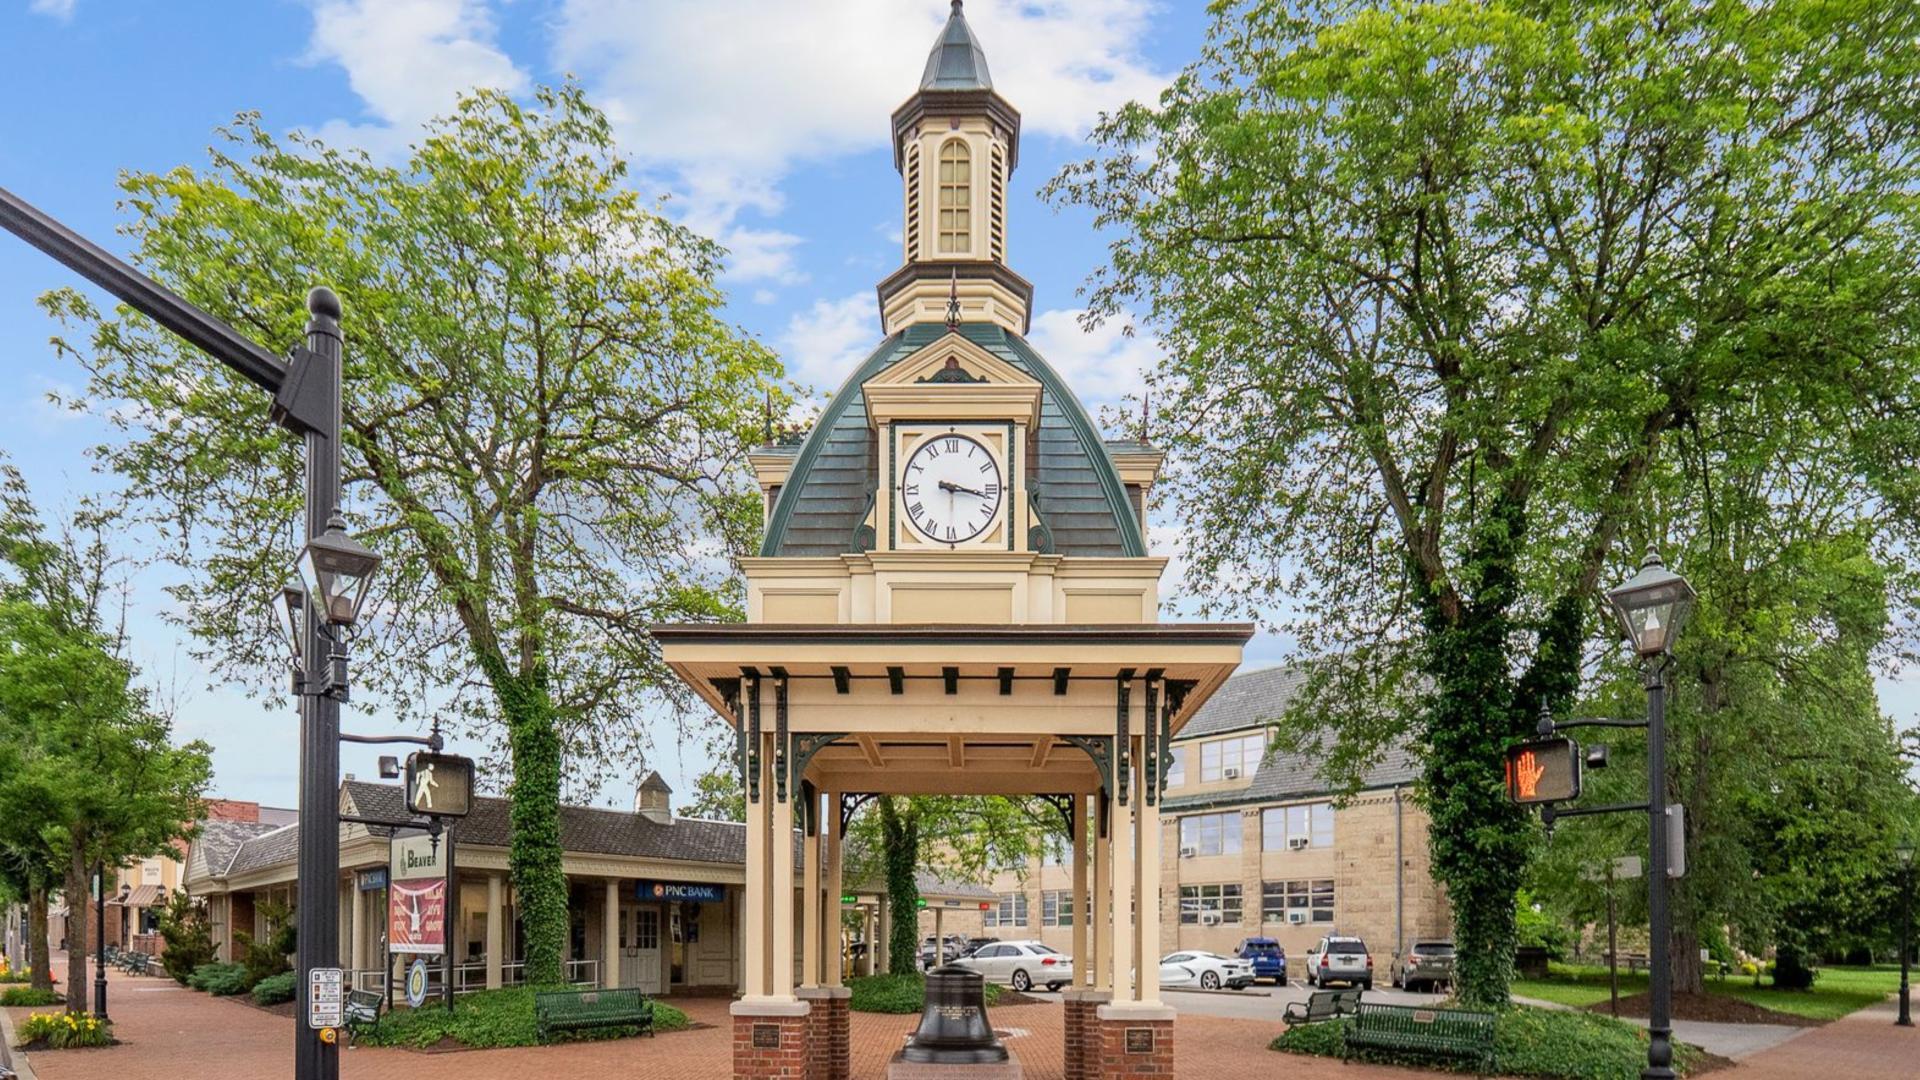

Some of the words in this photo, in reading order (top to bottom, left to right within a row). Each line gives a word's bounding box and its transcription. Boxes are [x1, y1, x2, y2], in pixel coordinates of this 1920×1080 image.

[925, 445, 939, 460] XI
[945, 439, 959, 453] XII
[968, 446, 976, 458] I
[912, 463, 924, 474] X
[980, 462, 992, 473] II
[907, 484, 919, 495] IX
[985, 484, 997, 494] III
[910, 502, 924, 520] VIII
[925, 519, 938, 535] VII
[946, 526, 957, 540] VI
[968, 521, 977, 534] V
